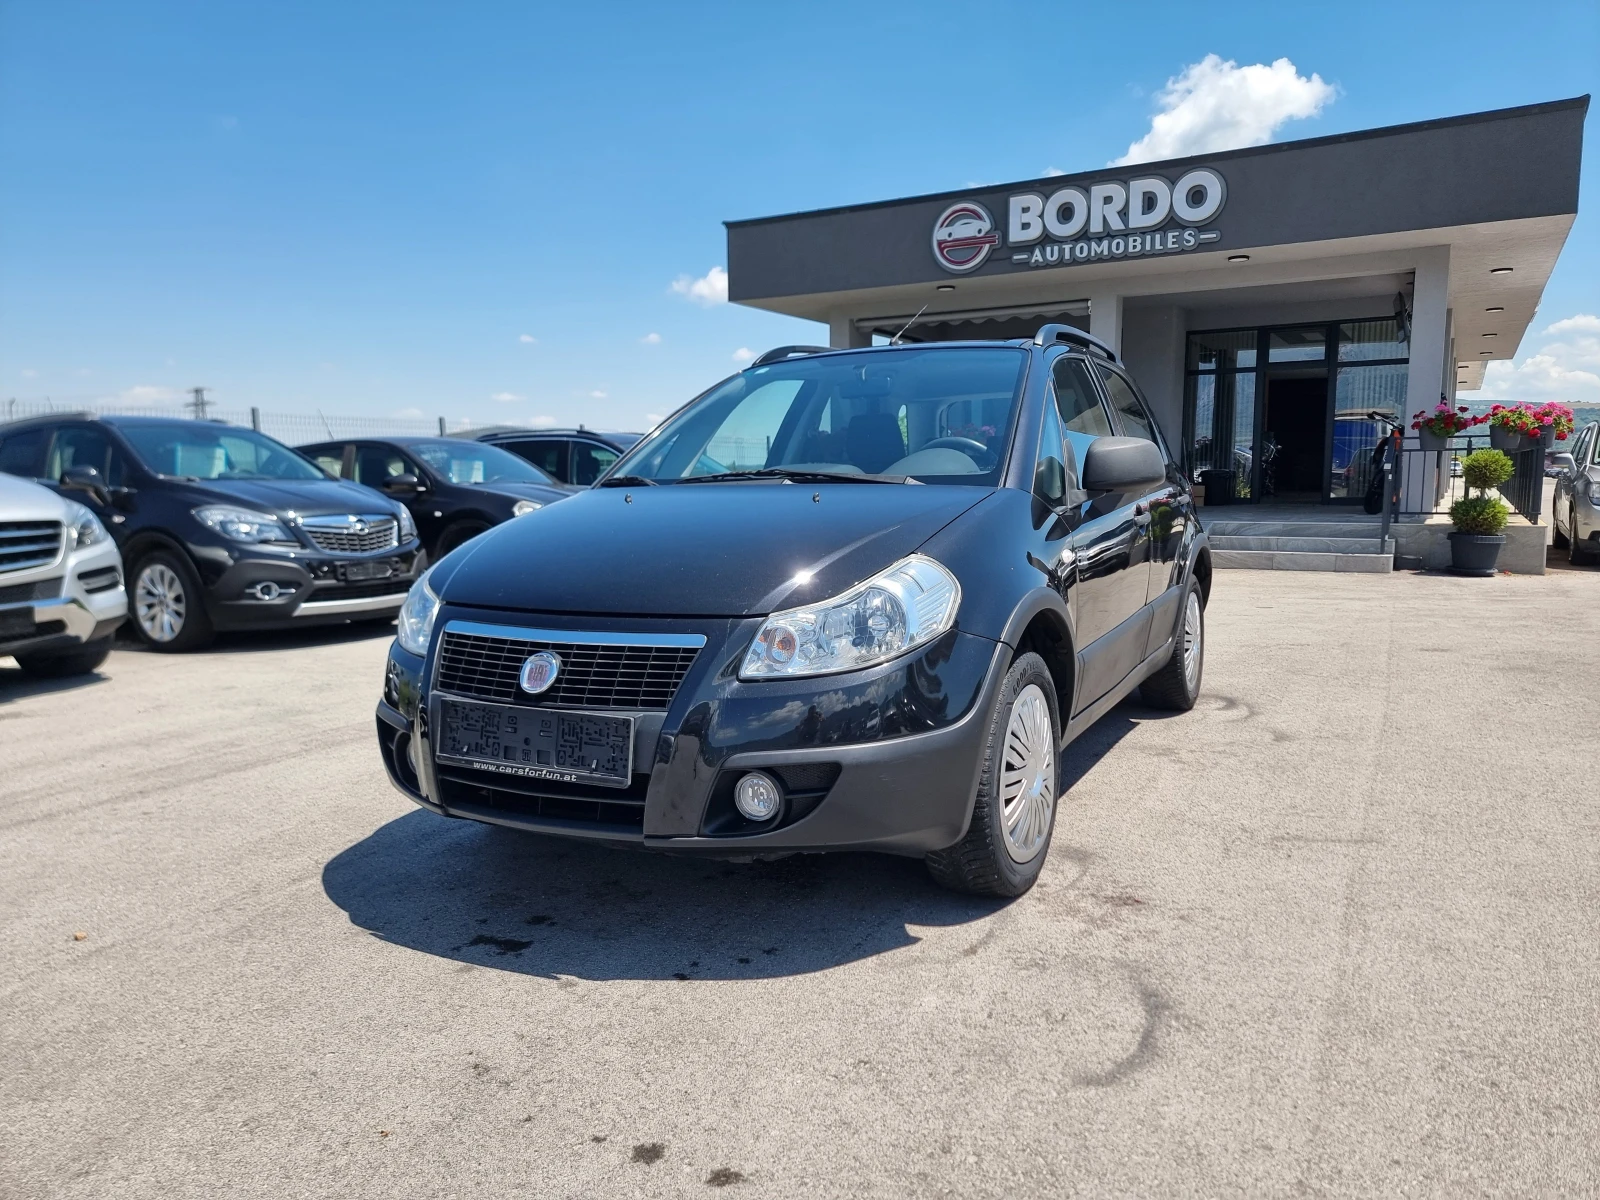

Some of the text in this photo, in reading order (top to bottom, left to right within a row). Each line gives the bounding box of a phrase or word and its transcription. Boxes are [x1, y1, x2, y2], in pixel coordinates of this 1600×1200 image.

[1008, 170, 1222, 243] BORDO
[1031, 230, 1196, 263] AUTOMOBILES
[473, 761, 577, 782] www.carsforfun.at
